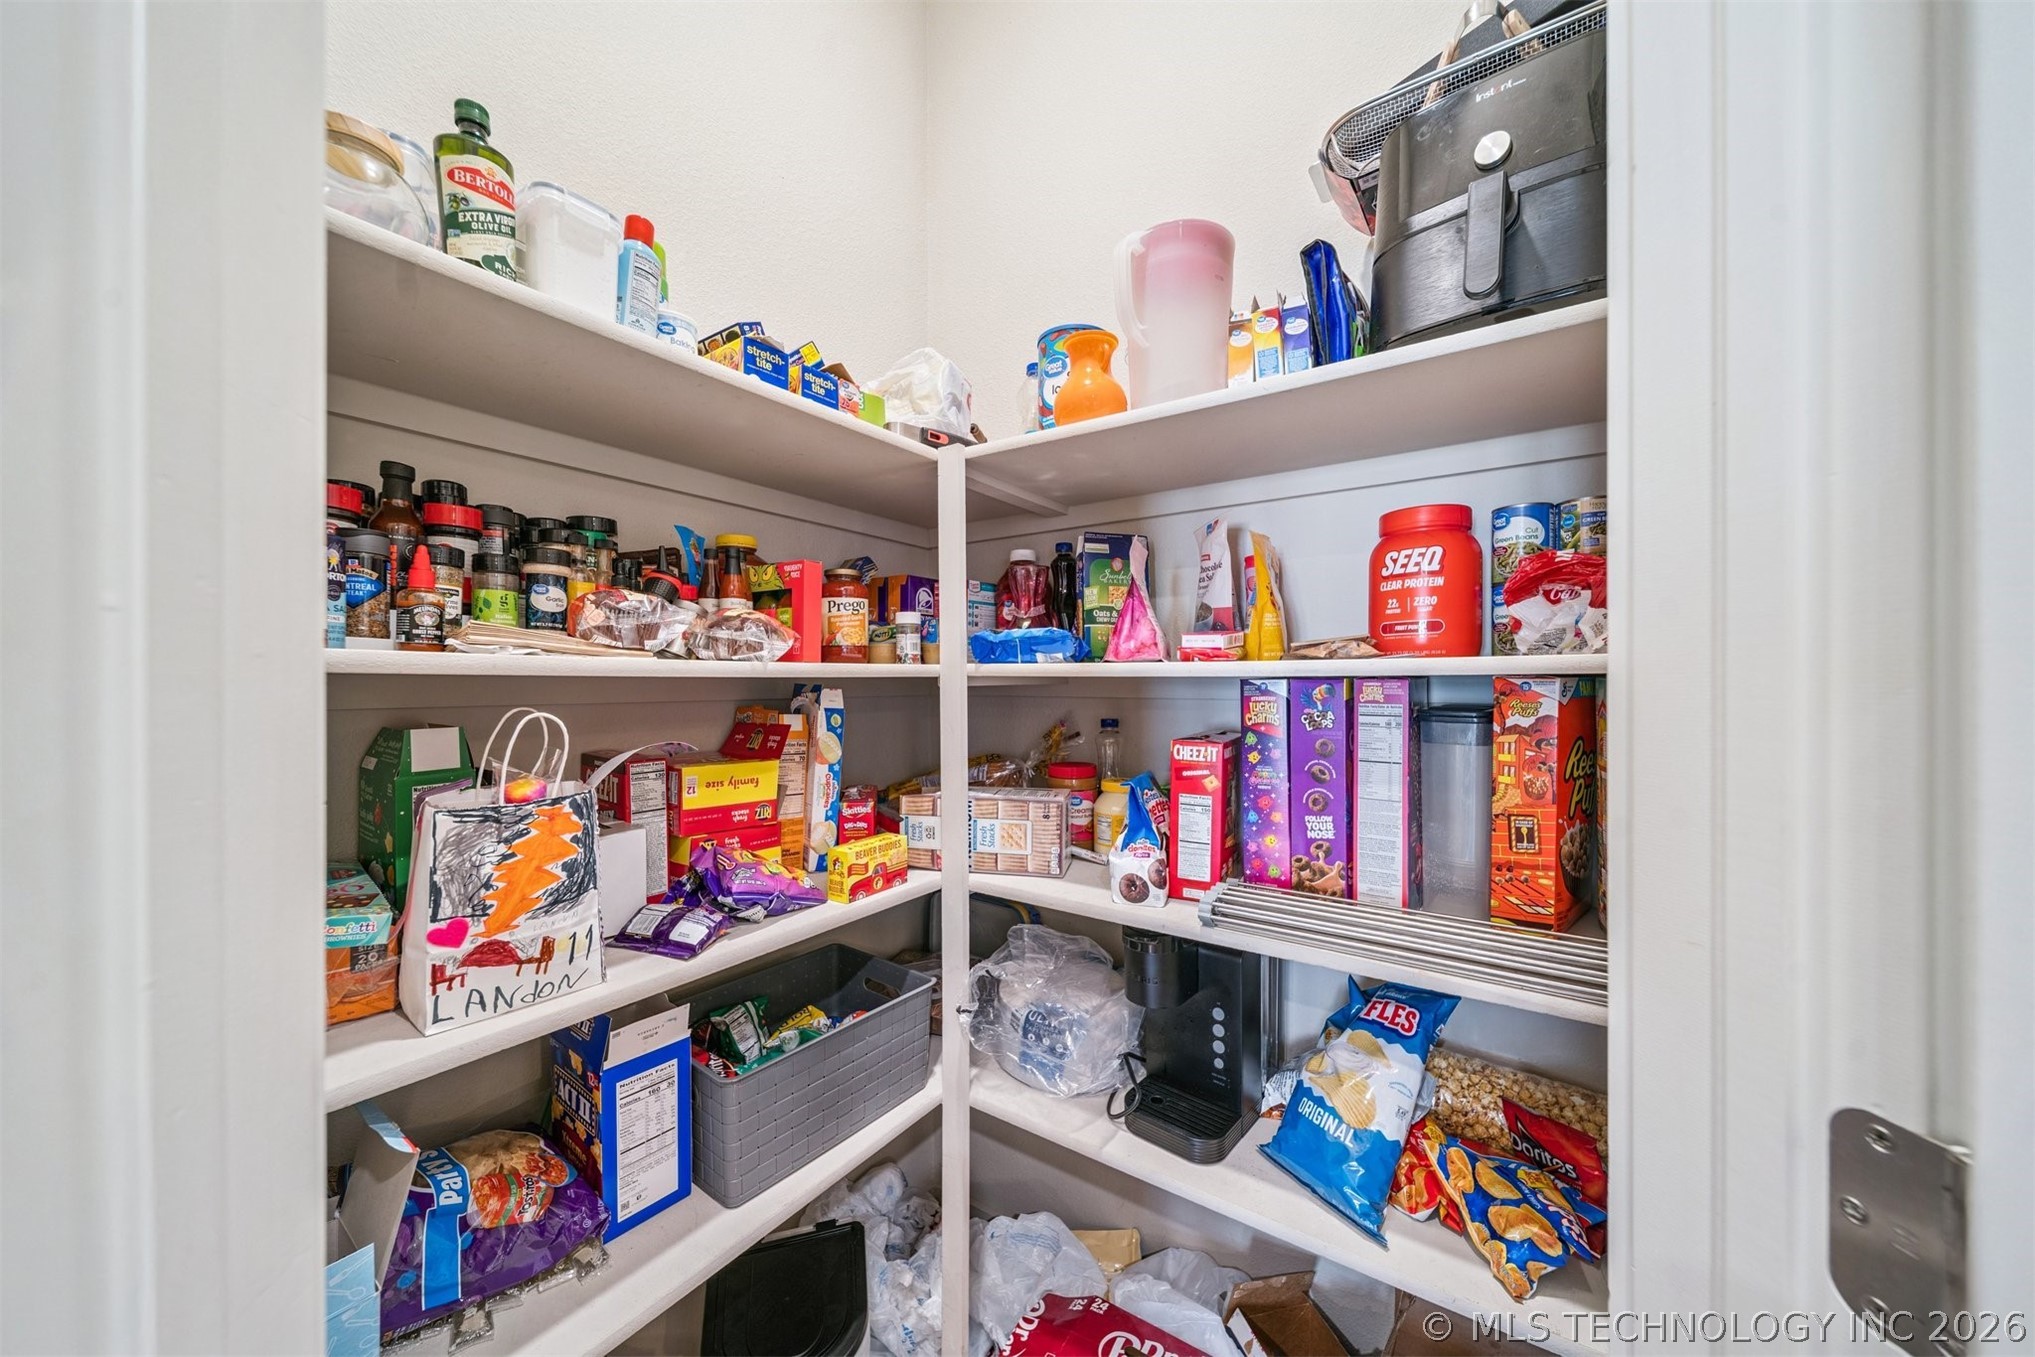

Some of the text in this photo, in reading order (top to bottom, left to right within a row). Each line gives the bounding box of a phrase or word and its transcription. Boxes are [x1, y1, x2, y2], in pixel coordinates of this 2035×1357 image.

[453, 168, 515, 205] BERTOLL
[458, 211, 492, 223] EXTRA
[471, 222, 499, 231] OLIVE
[501, 224, 512, 234] OIL
[494, 261, 516, 277] RIC
[746, 344, 786, 366] stretch-
[755, 357, 773, 372] tite
[804, 371, 836, 391] stretch-
[811, 382, 826, 396] tite
[1381, 545, 1444, 577] SEEQ
[1100, 568, 1132, 581] Sunbel
[1379, 576, 1445, 592] CLEAR PROTEIN
[545, 596, 565, 604] Garlic
[827, 599, 866, 616] Prego
[1413, 595, 1438, 607] ZERO
[1093, 609, 1110, 617] Oats
[1359, 693, 1385, 703] Charms
[1362, 685, 1383, 695] Lucky
[1249, 701, 1278, 715] Lucky
[1245, 711, 1280, 727] Charms
[1301, 710, 1336, 724] COCOA
[1305, 719, 1334, 732] LOOPS
[1173, 743, 1219, 763] CHEEZ-IT
[686, 785, 697, 795] 12
[705, 775, 760, 792] family size
[823, 773, 833, 809] Cupcakes
[755, 805, 772, 820] RITZ
[841, 805, 872, 817] Skittles
[1304, 815, 1333, 823] FOLLOW
[916, 820, 924, 842] Stacks
[1305, 822, 1334, 831] YOUR
[1306, 830, 1336, 839] NOSE
[979, 825, 988, 847] Fresh
[987, 823, 996, 848] Stacks
[855, 839, 902, 861] BEAVER BUDDIES
[568, 923, 594, 966] 11
[359, 952, 378, 964] 20
[1363, 998, 1418, 1034] FLES
[619, 1062, 676, 1089] Nutrition Facts
[557, 1080, 591, 1124] ACT II
[619, 1095, 641, 1110] Calories
[1297, 1096, 1356, 1149] ORIGINAL
[1510, 1131, 1578, 1179] Doritos
[420, 1157, 463, 1206] Party
[1091, 1297, 1110, 1312] 24
[1015, 1314, 1041, 1342] Dr
